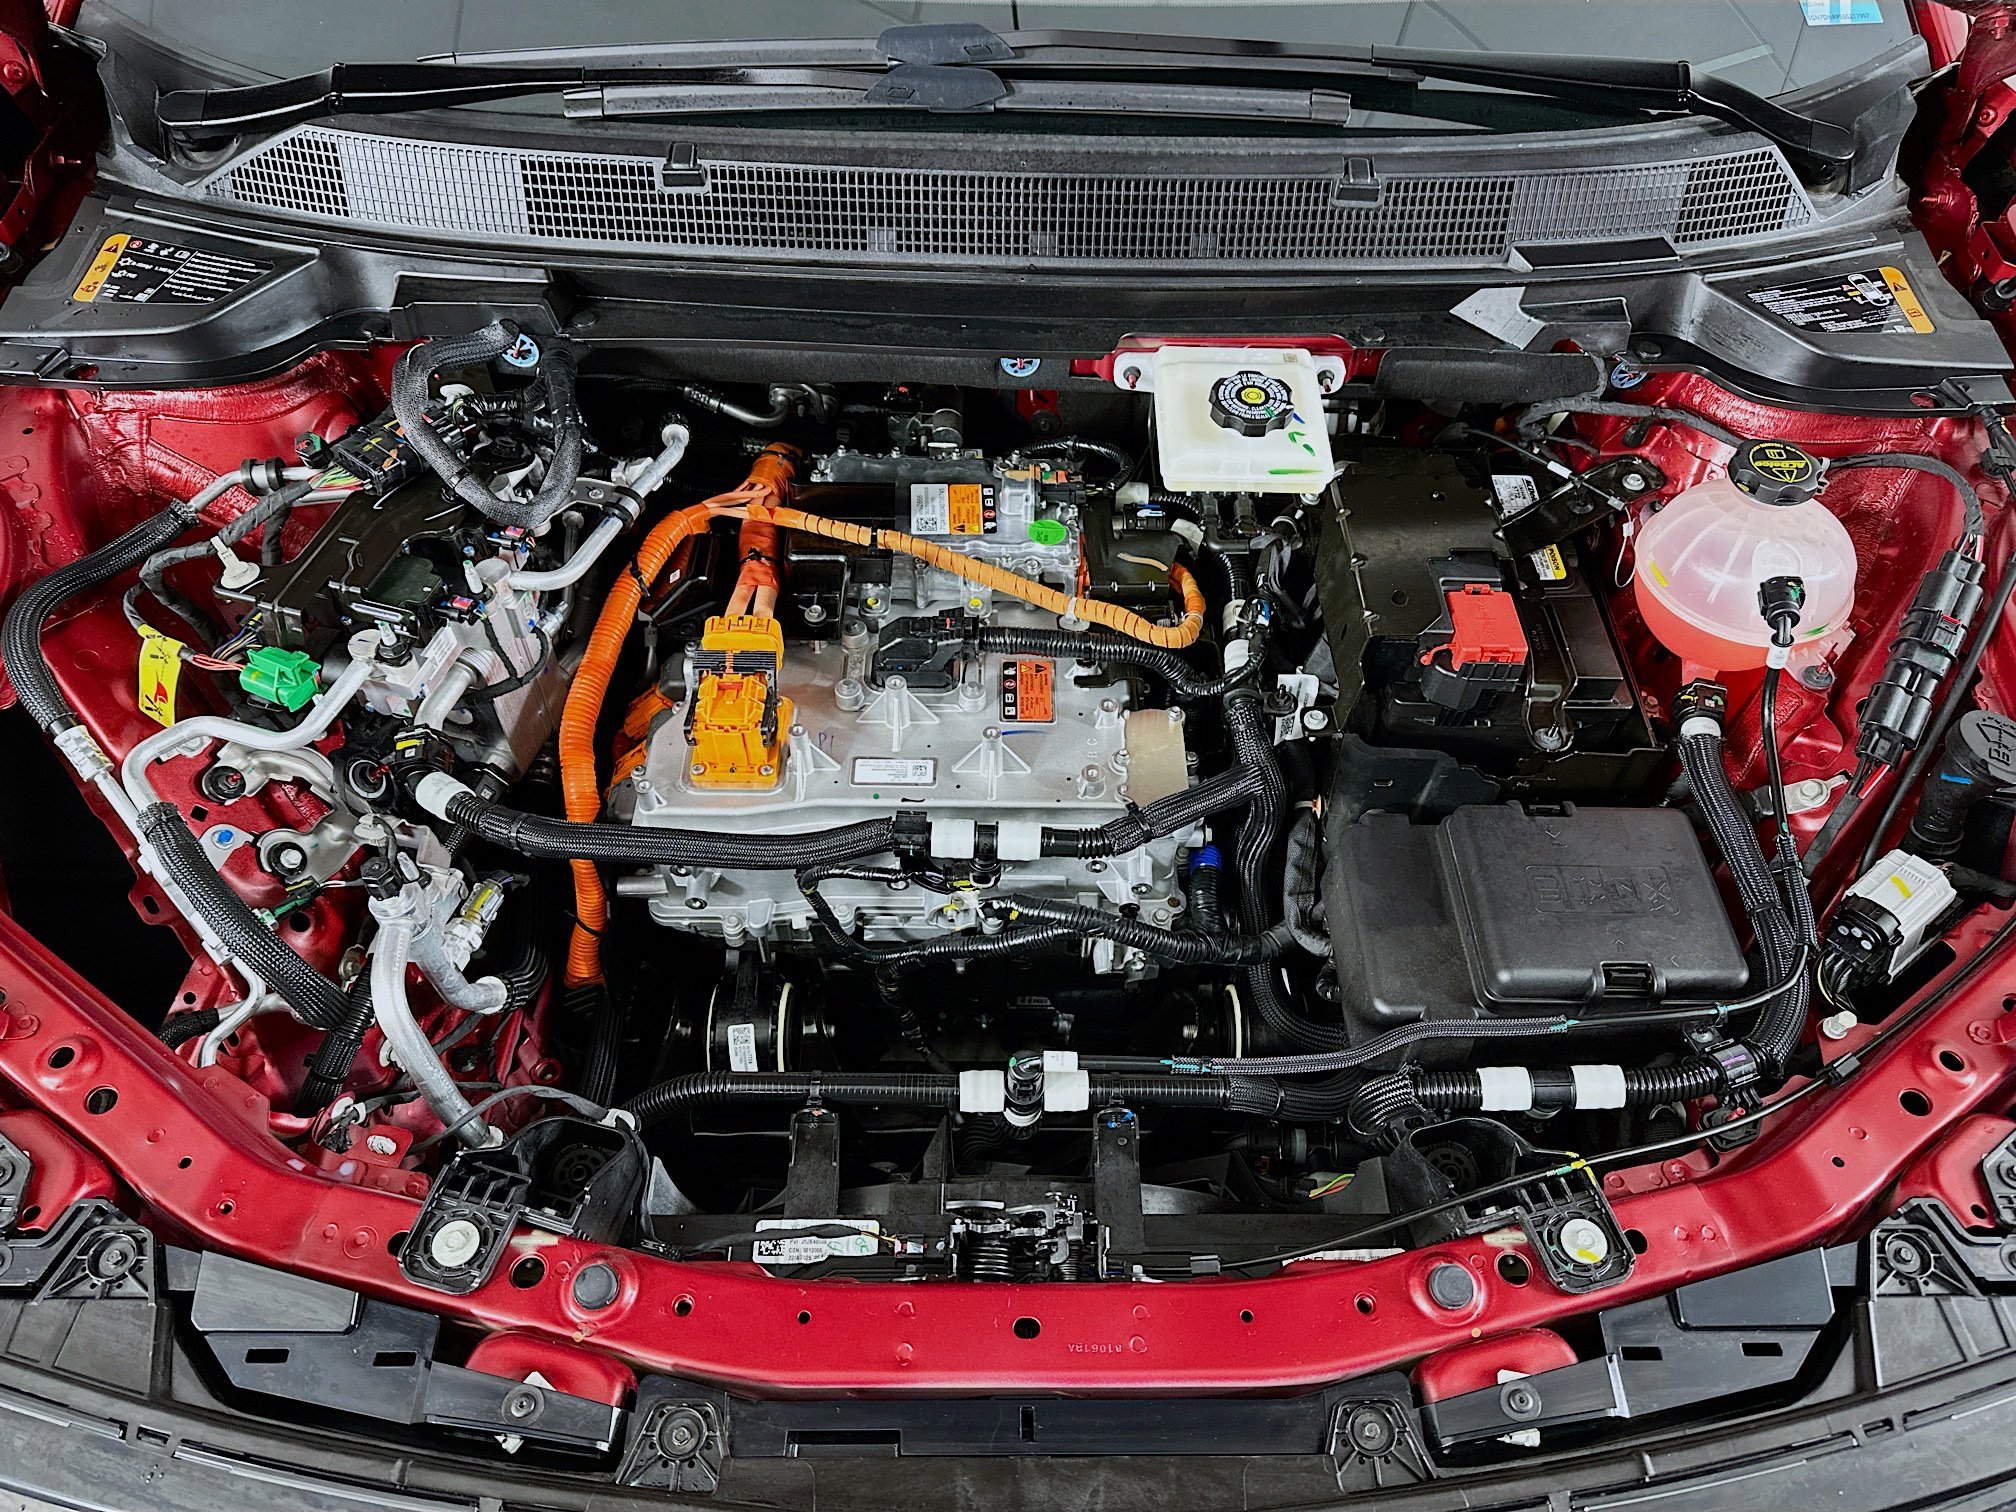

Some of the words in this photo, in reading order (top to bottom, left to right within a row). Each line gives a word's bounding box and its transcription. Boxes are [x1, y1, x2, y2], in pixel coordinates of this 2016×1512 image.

[1754, 460, 1807, 468] ACDelco
[1525, 479, 1541, 503] ACDel
[1548, 548, 1560, 571] POISON
